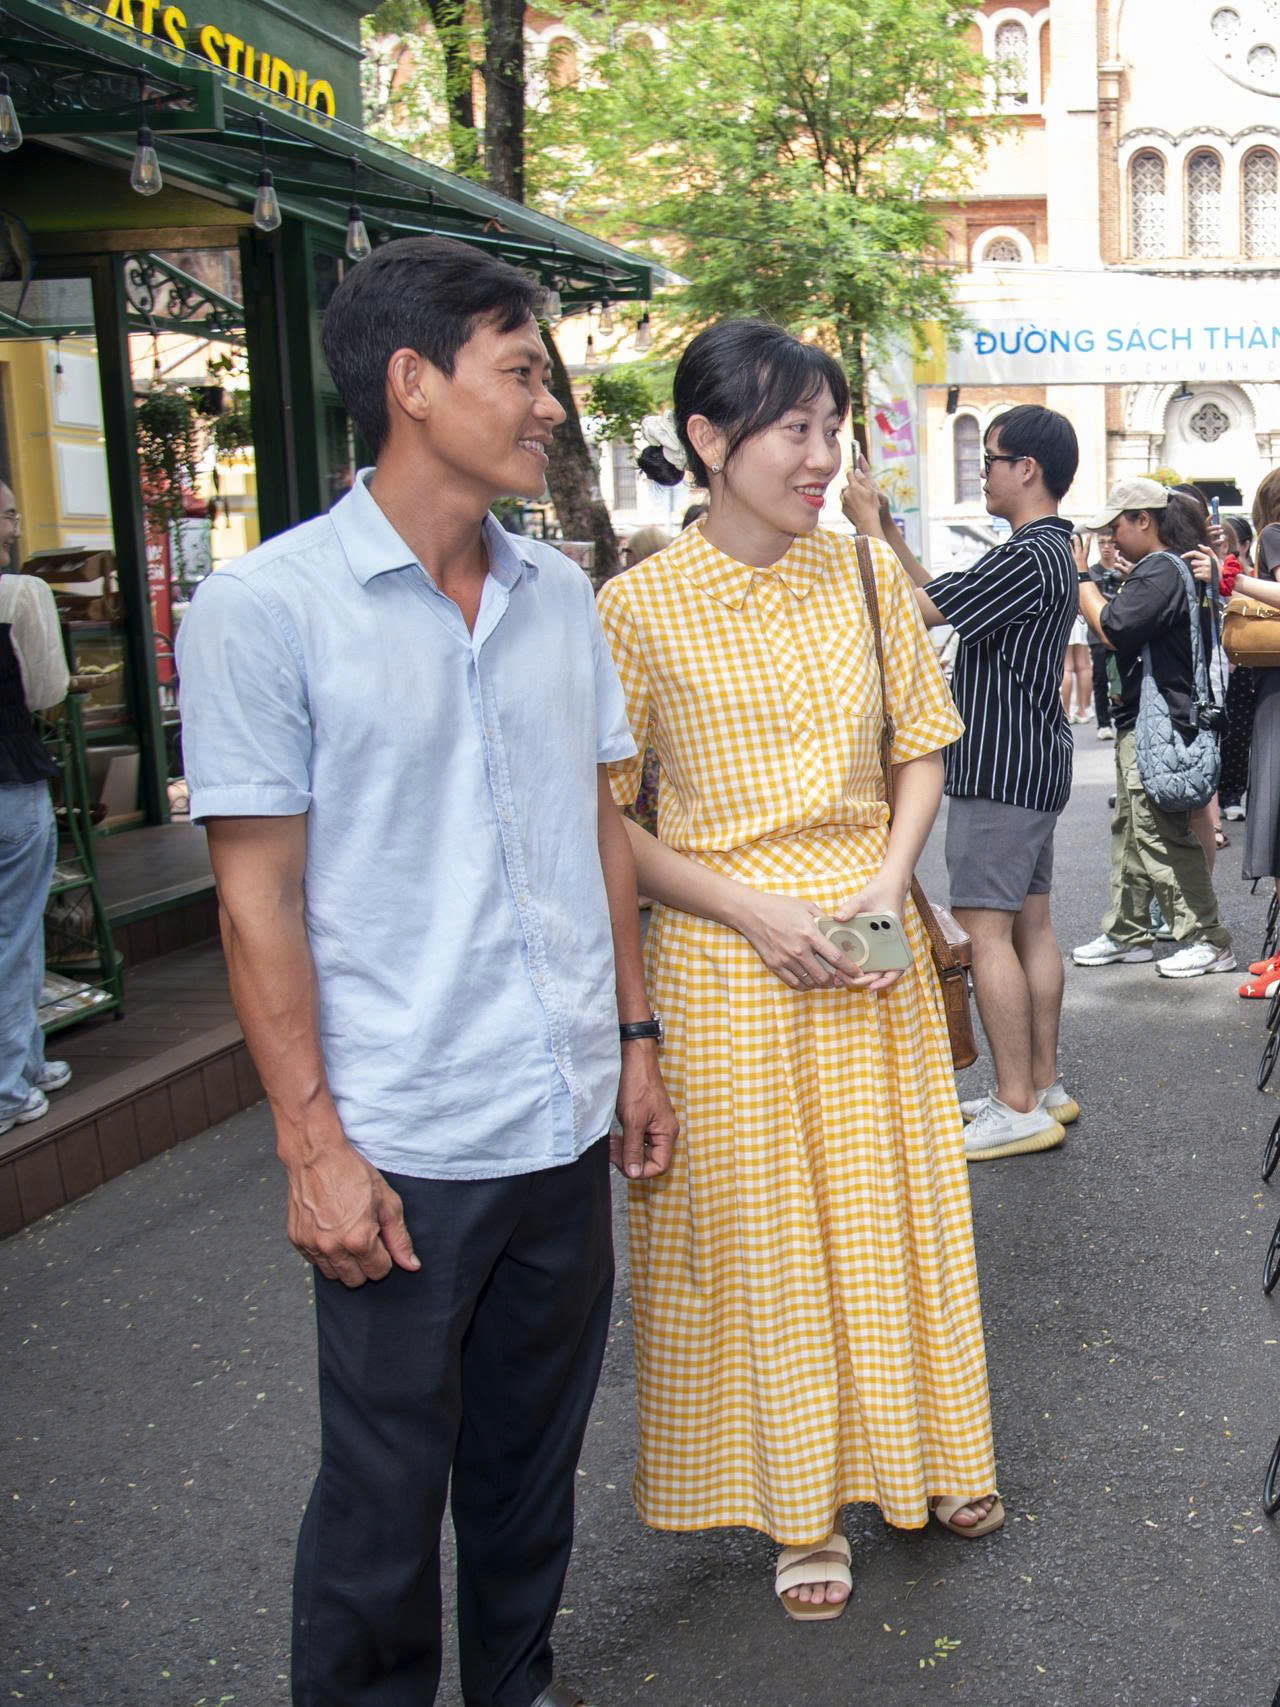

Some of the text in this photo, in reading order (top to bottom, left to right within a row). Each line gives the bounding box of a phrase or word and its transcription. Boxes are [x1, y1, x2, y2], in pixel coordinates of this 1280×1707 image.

[200, 24, 336, 122] STUDIO
[975, 324, 1095, 354] ĐƯỜNG
[1106, 322, 1191, 351] SÁCH
